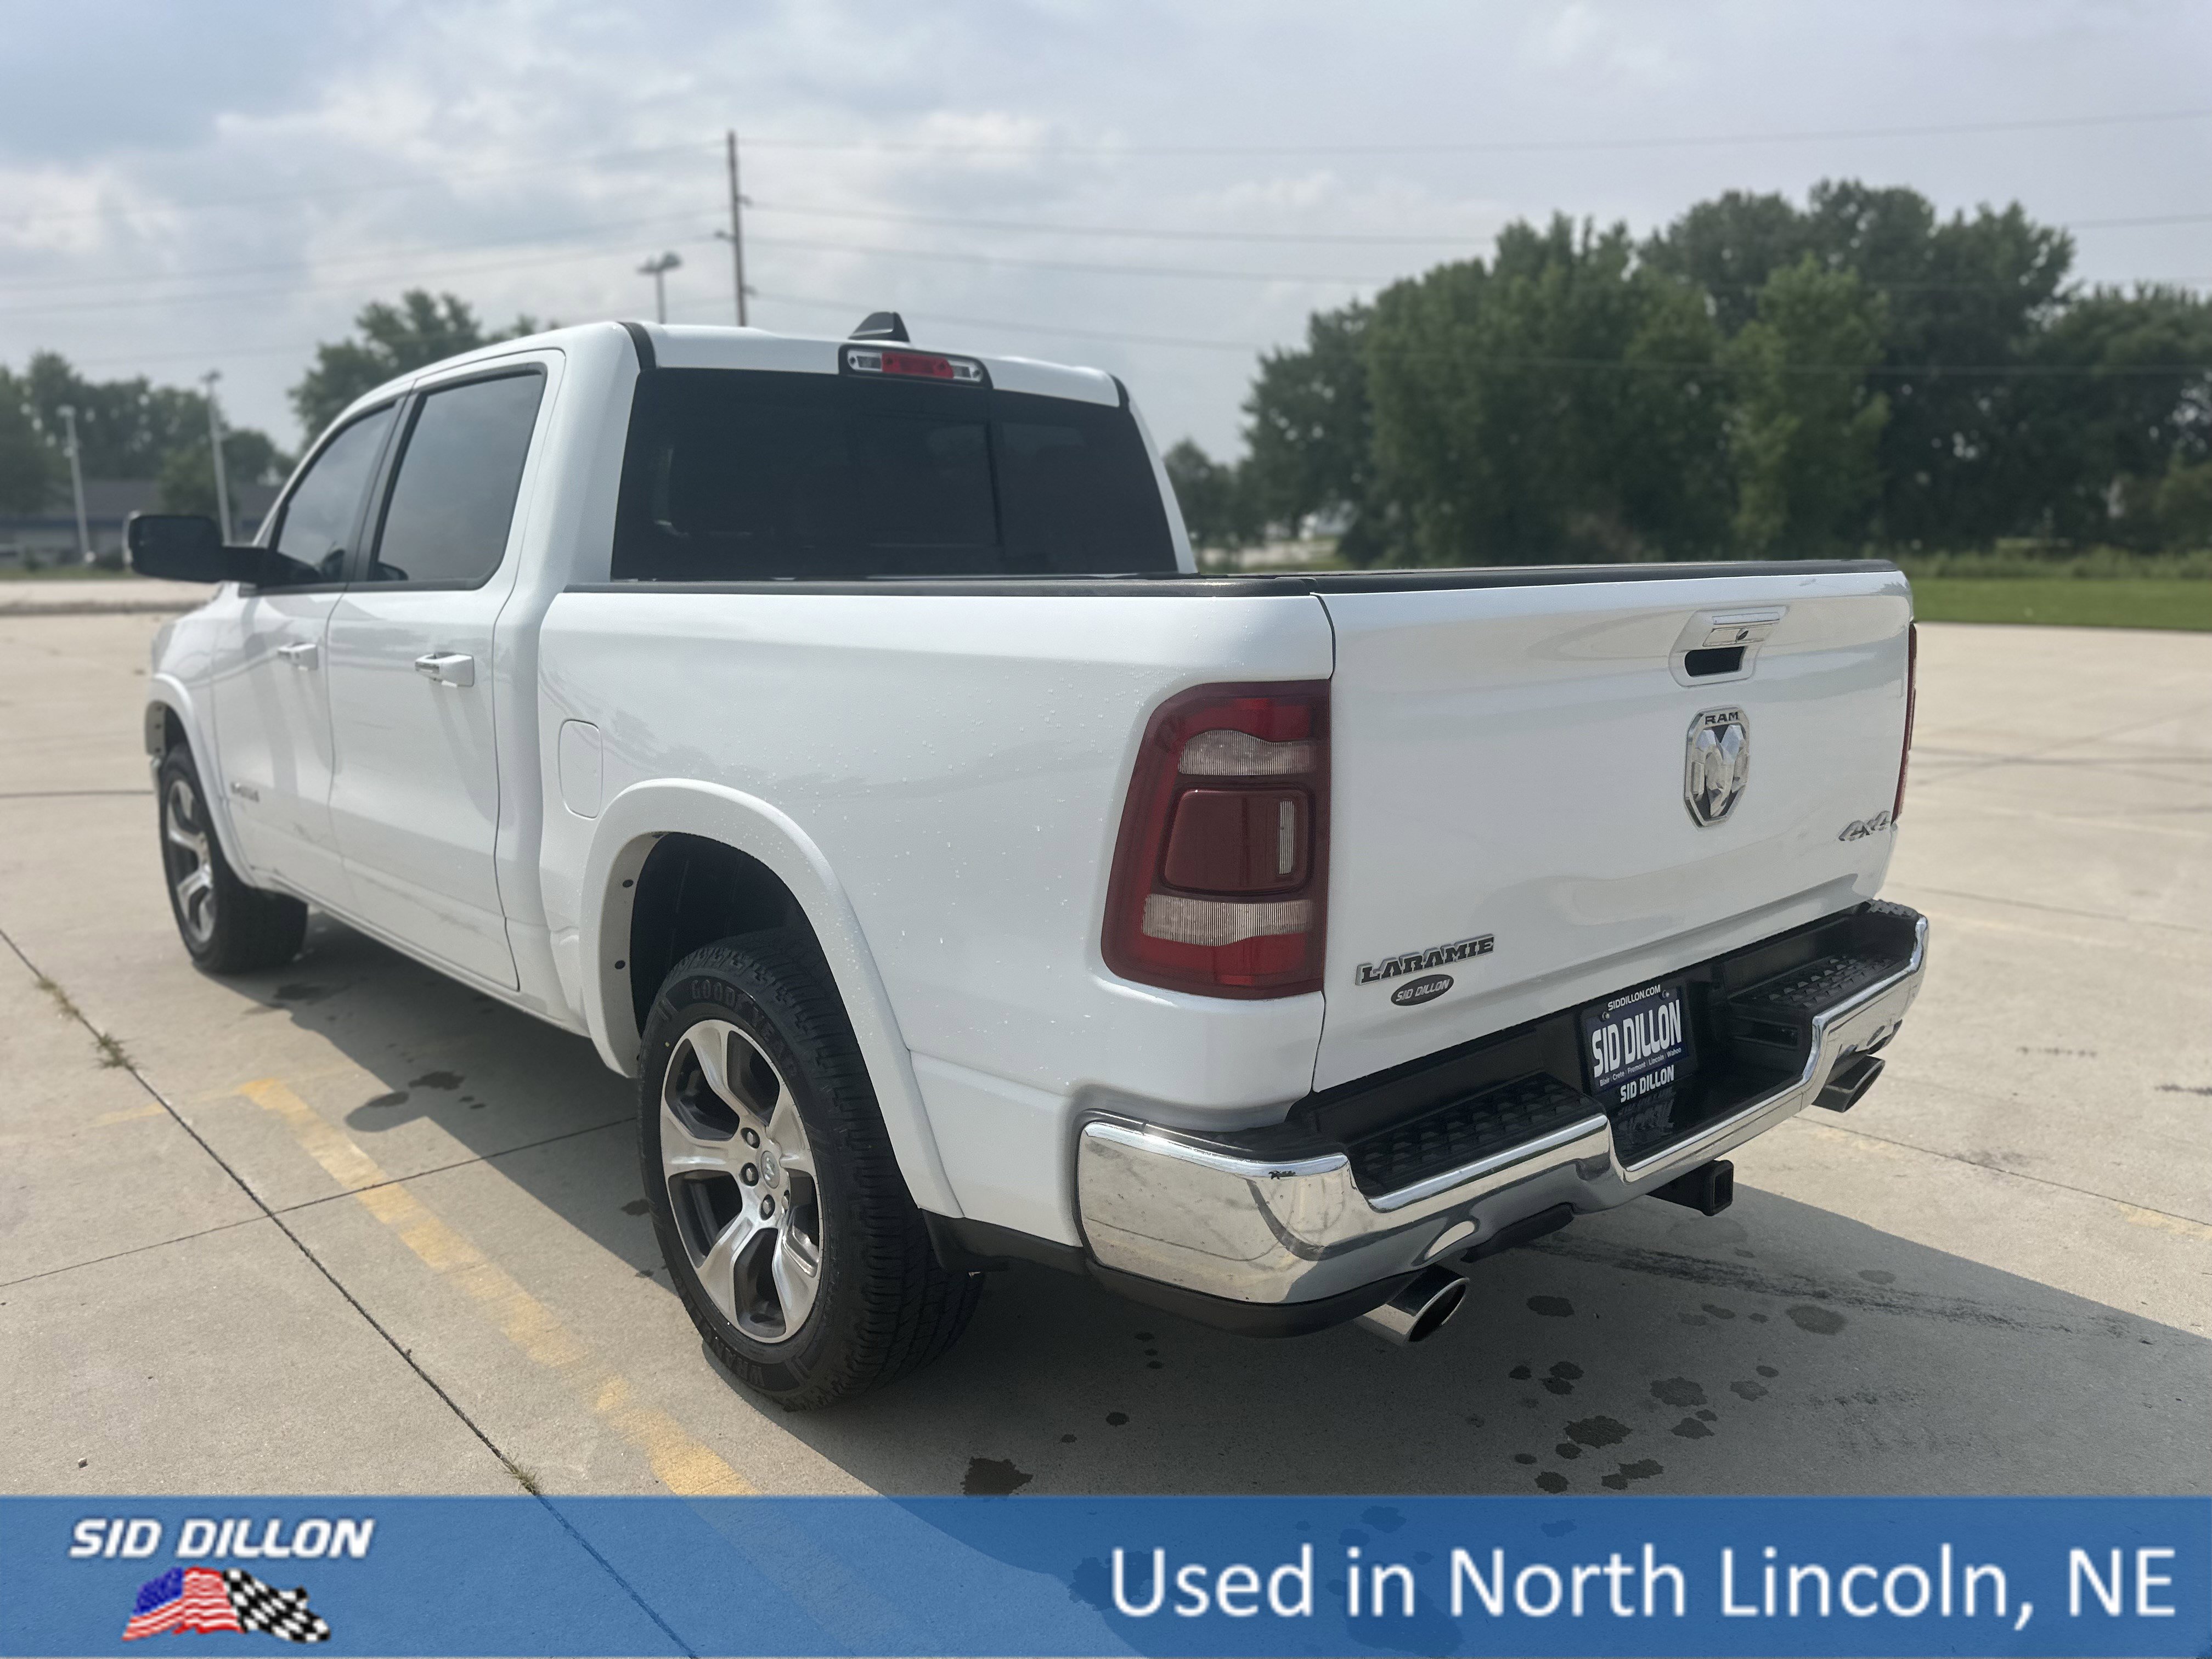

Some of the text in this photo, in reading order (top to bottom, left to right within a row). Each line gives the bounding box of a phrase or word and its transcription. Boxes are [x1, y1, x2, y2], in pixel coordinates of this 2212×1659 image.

[1705, 711, 1739, 725] RAM
[1356, 934, 1494, 985] LARAMIE
[1395, 978, 1450, 1002] SID DILLON
[1607, 984, 1661, 1012] SIDDILLON.COM
[1592, 999, 1681, 1078] SID DILLON
[1612, 1070, 1625, 1081] Crete
[1627, 1062, 1646, 1074] Fremont
[1649, 1054, 1664, 1065] Lincoln
[1620, 1064, 1674, 1103] SID DILLON
